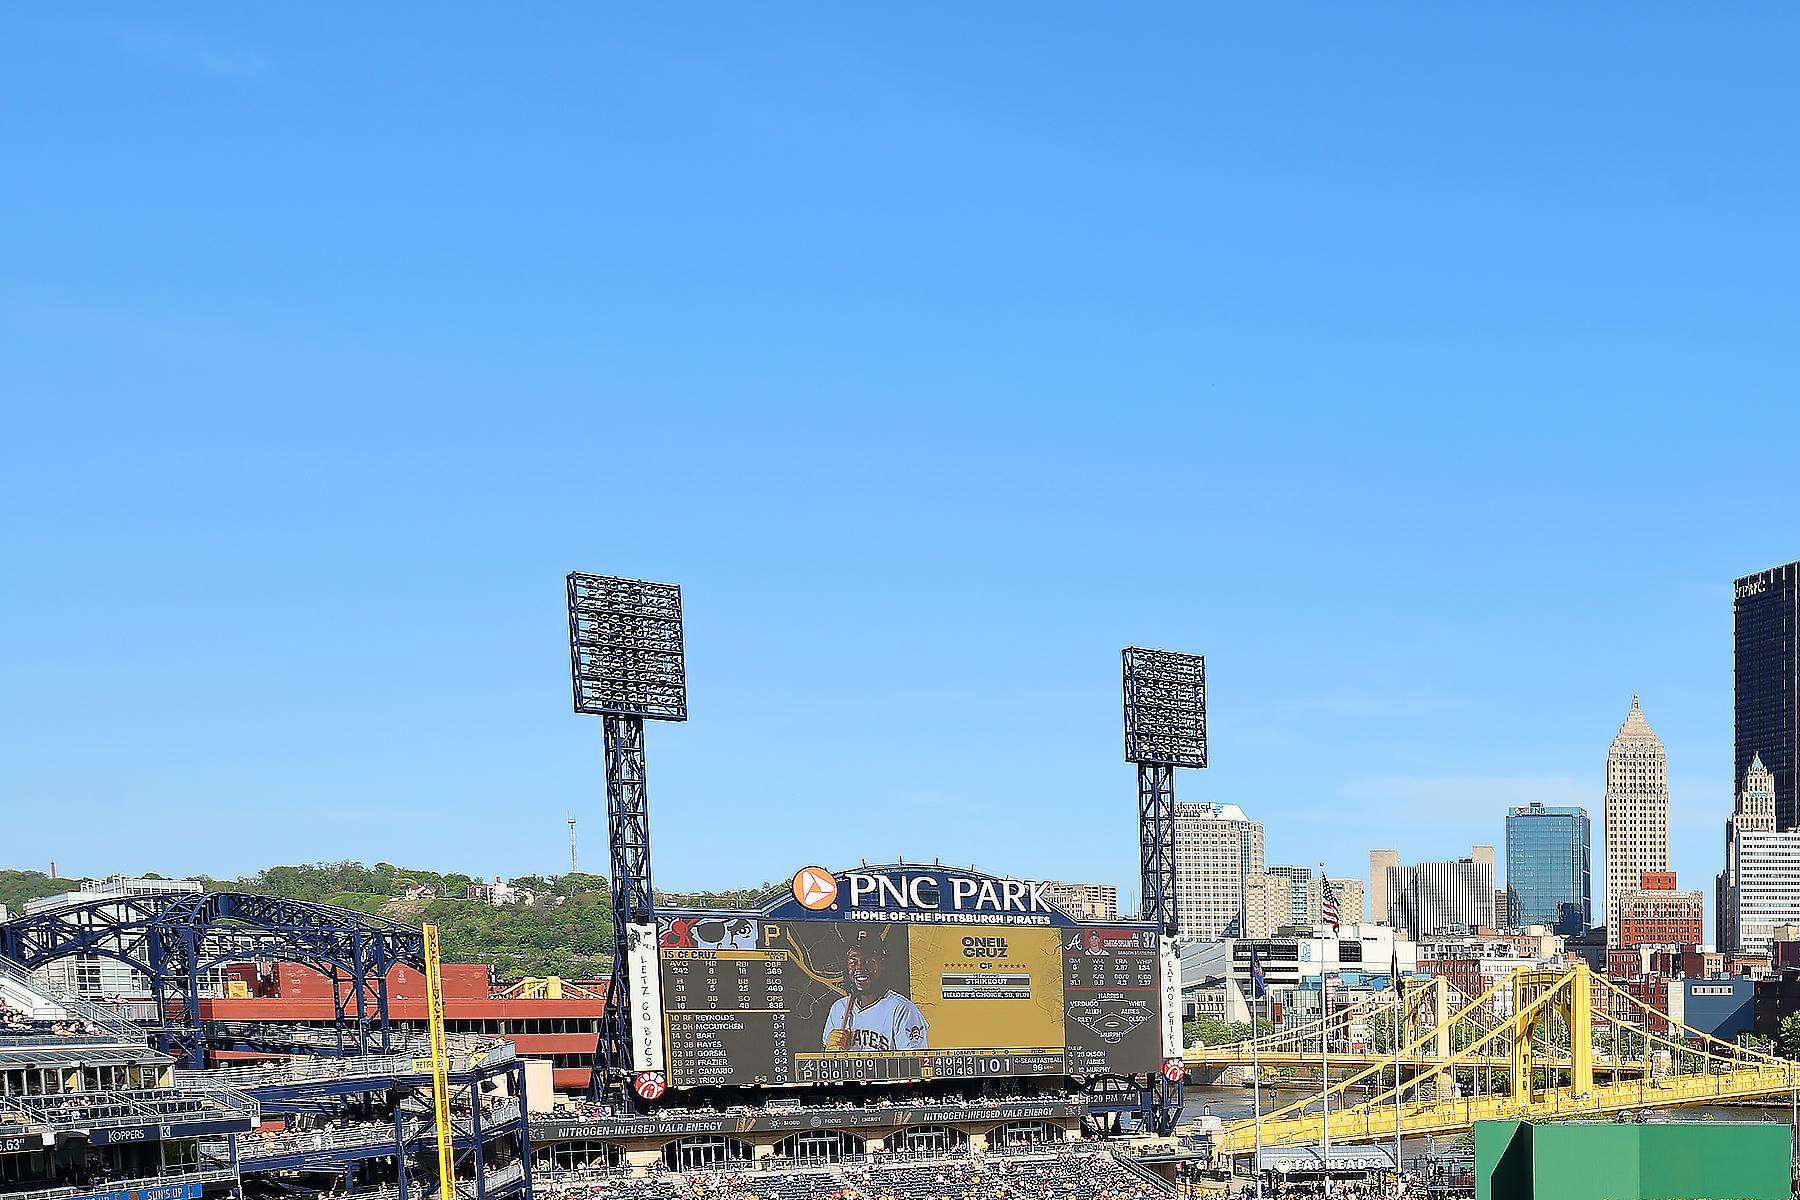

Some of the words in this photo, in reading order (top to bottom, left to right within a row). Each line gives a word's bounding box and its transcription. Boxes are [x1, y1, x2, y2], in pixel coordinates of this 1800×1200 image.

[1734, 580, 1767, 600] UPMC
[1530, 806, 1546, 815] FNB
[843, 873, 939, 909] PNC
[948, 876, 1053, 912] PARK
[851, 910, 887, 921] HOME
[889, 911, 906, 921] OF
[909, 911, 932, 922] THE
[934, 912, 1003, 924] PITTSBURGH
[1006, 914, 1051, 926] PIRATES
[763, 924, 781, 946] P
[961, 936, 1008, 947] ONEIL
[1142, 931, 1157, 949] 32
[663, 951, 675, 959] 15
[691, 951, 718, 959] CRUZ
[963, 947, 1008, 958] CRUZ
[979, 961, 993, 969] CF
[851, 1030, 890, 1051] ATES
[698, 1067, 734, 1075] CANARIO
[1032, 1063, 1043, 1072] 96
[698, 1076, 725, 1084] TRIOLO
[1105, 1094, 1118, 1102] PM
[923, 1109, 1000, 1121] NITROGEN-INFUSED
[1002, 1108, 1022, 1118] VALR
[1023, 1106, 1054, 1117] ENERGY
[558, 1121, 656, 1138] NITROGEN-INFUSED
[658, 1121, 684, 1134] VALR
[685, 1120, 723, 1133] ENERGY
[108, 1129, 145, 1143] KOPPERS
[1295, 1159, 1321, 1171] FAT
[1326, 1157, 1383, 1170] HEAD'S
[147, 1189, 171, 1200] SUN'S
[172, 1187, 183, 1199] UP
